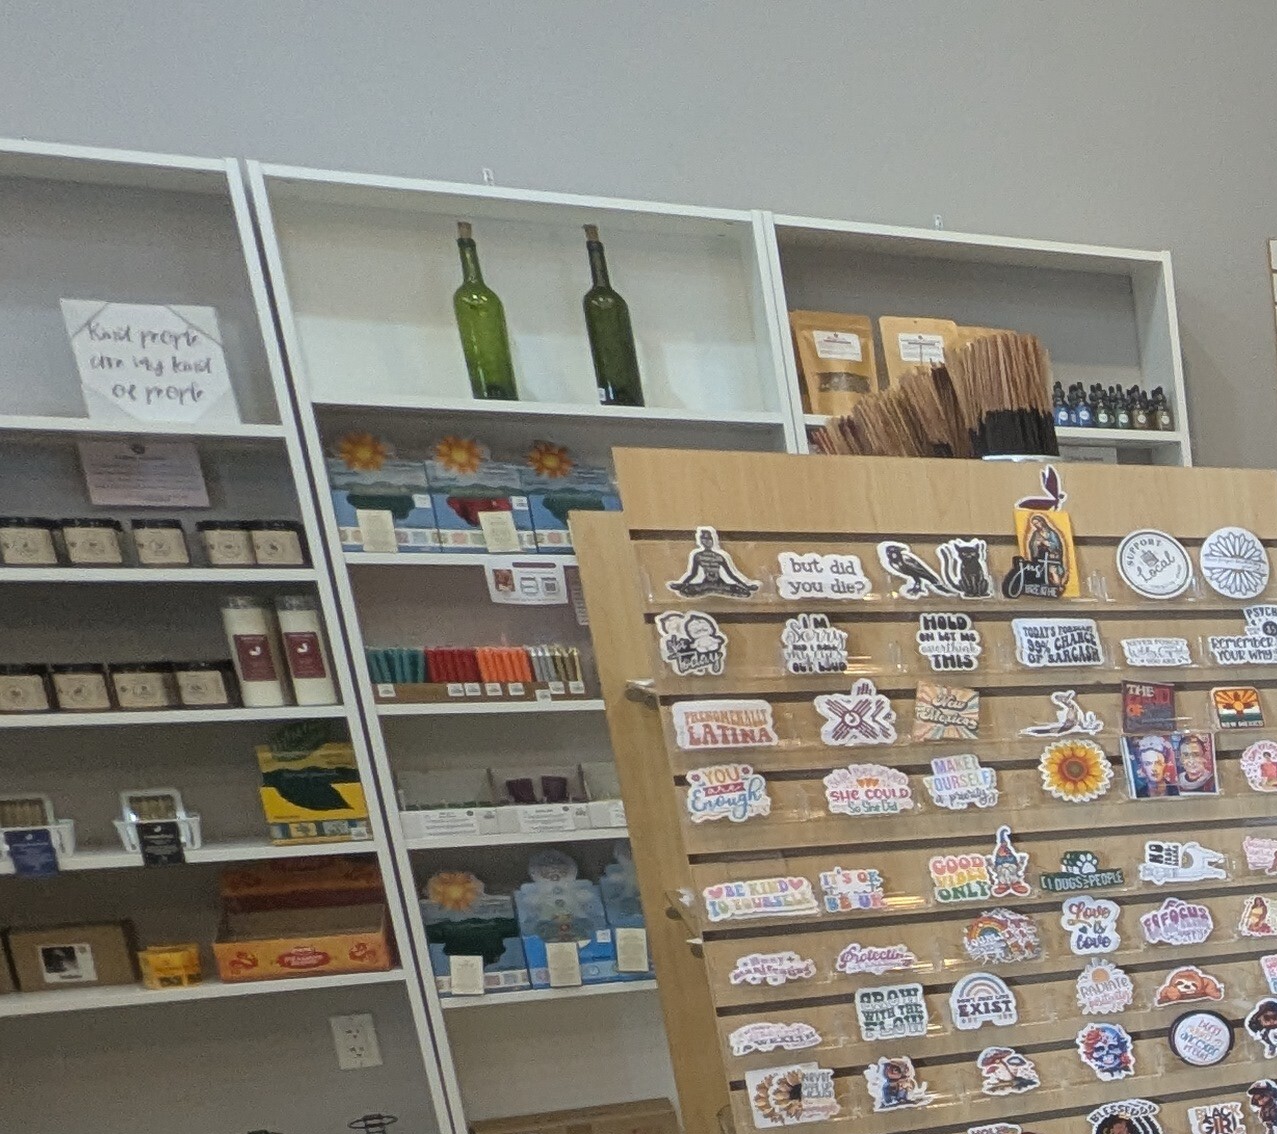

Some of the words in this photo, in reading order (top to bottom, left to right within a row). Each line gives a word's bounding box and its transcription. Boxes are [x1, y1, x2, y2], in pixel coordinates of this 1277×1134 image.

[1127, 538, 1163, 567] SUPPORT
[790, 557, 823, 574] but
[830, 556, 856, 575] did
[1138, 552, 1176, 582] Local
[1008, 552, 1060, 596] just
[788, 580, 823, 595] you
[831, 579, 866, 594] die?
[923, 617, 966, 630] HOLD
[1055, 632, 1096, 649] CHANCE
[934, 654, 972, 669] THIS
[1027, 653, 1044, 663] OF
[1048, 648, 1100, 663] SARCASM
[688, 725, 772, 745] LATINA
[703, 768, 739, 783] YOU
[691, 778, 763, 818] Enough
[865, 789, 909, 800] COULD
[932, 858, 984, 872] GOOD
[937, 886, 990, 901] ONLY
[860, 988, 920, 1003] GROW
[1081, 979, 1129, 999] RADIATE
[959, 1000, 1013, 1017] EXIST
